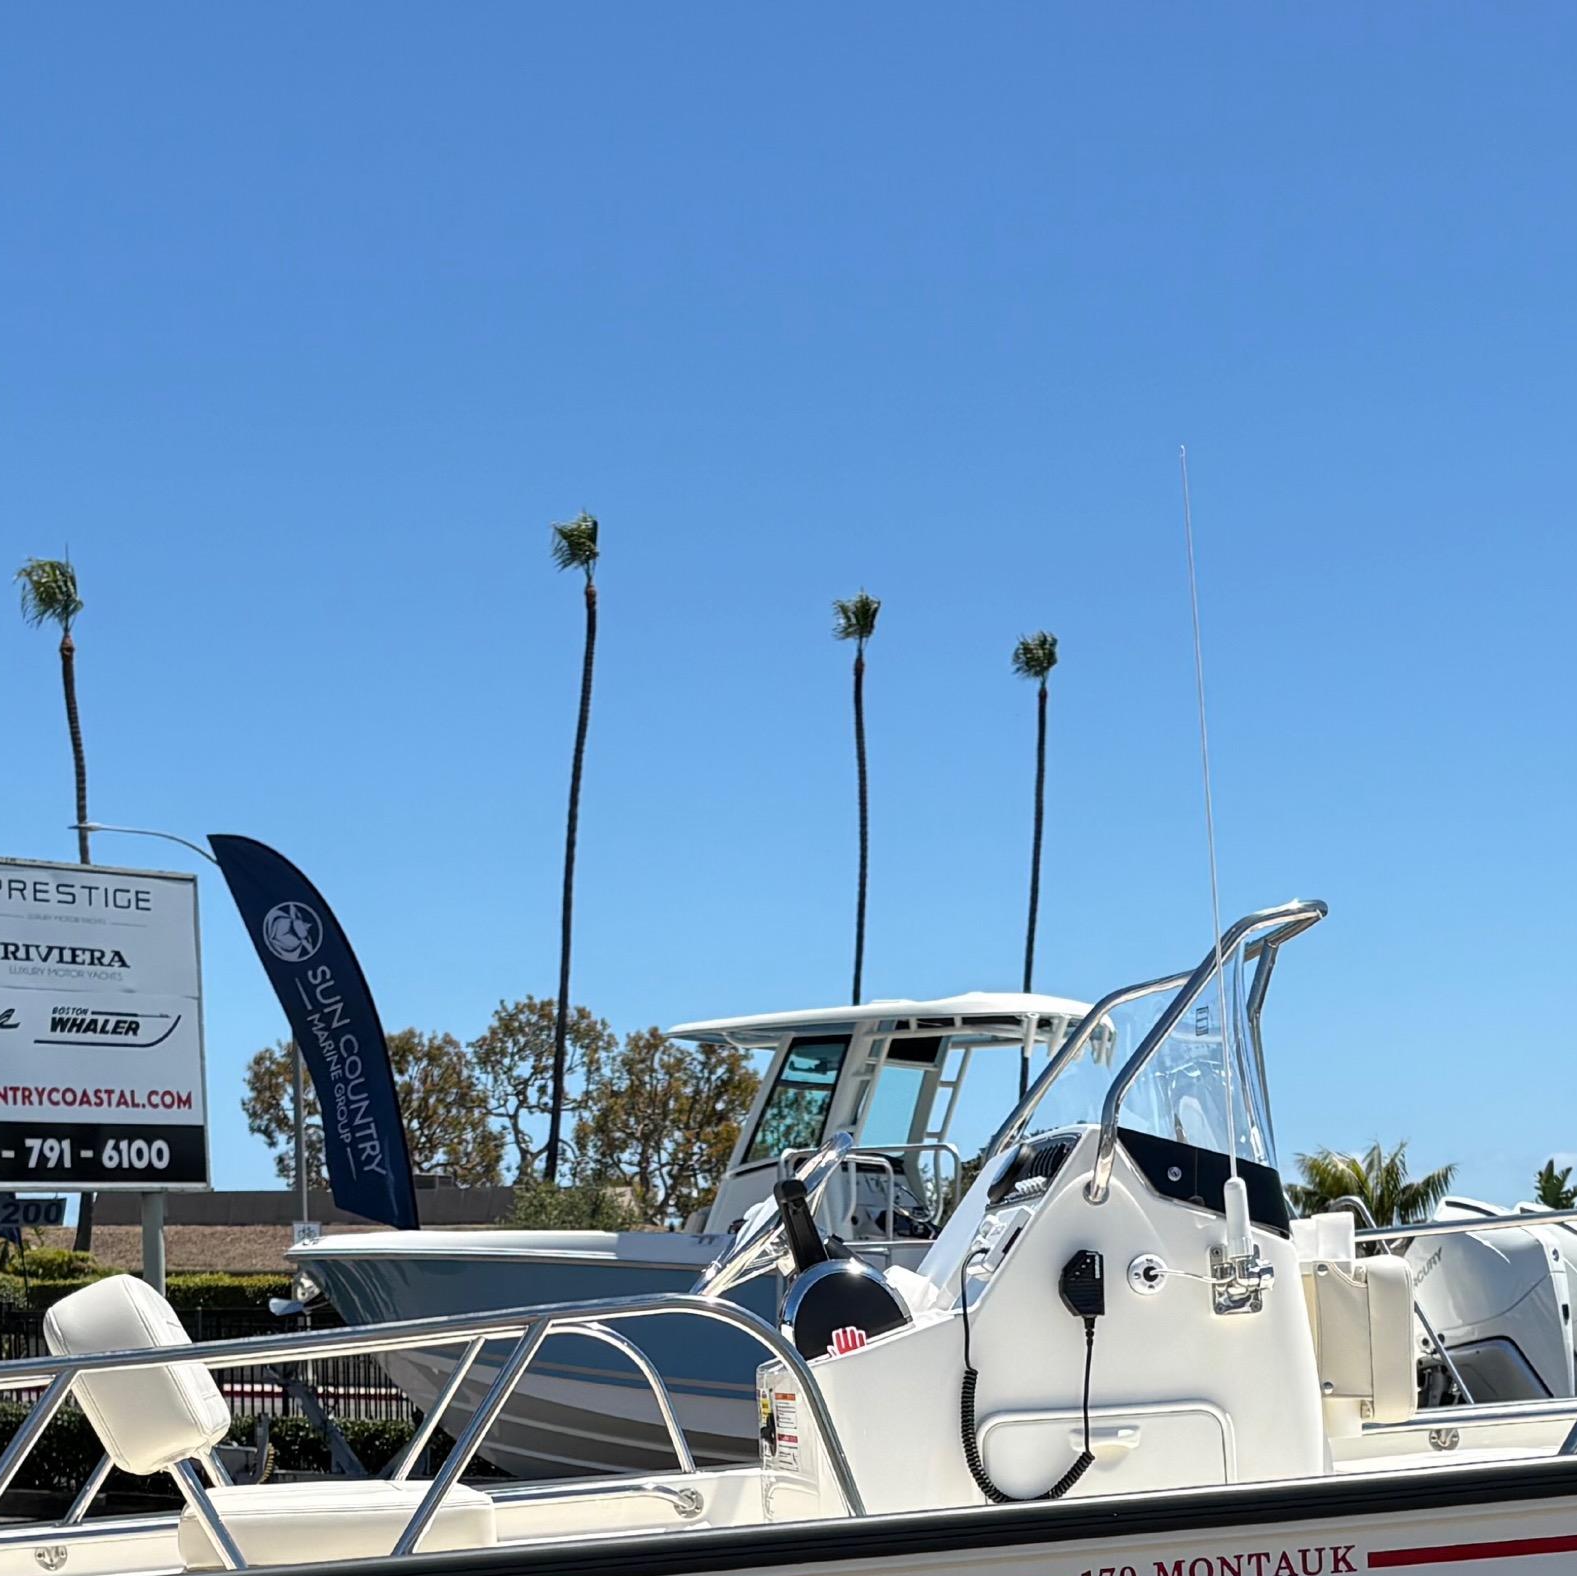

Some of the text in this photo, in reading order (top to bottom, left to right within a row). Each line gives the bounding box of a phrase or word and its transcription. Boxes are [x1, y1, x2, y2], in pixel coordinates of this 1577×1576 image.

[0, 942, 131, 969] RIVIERA
[49, 1016, 141, 1037] WHALER
[51, 1006, 90, 1017] BOSTON
[306, 1013, 353, 1145] MARINE GROUP
[308, 964, 387, 1177] SUN COUNTRY
[24, 1137, 72, 1169] 791
[102, 1138, 171, 1170] 6100
